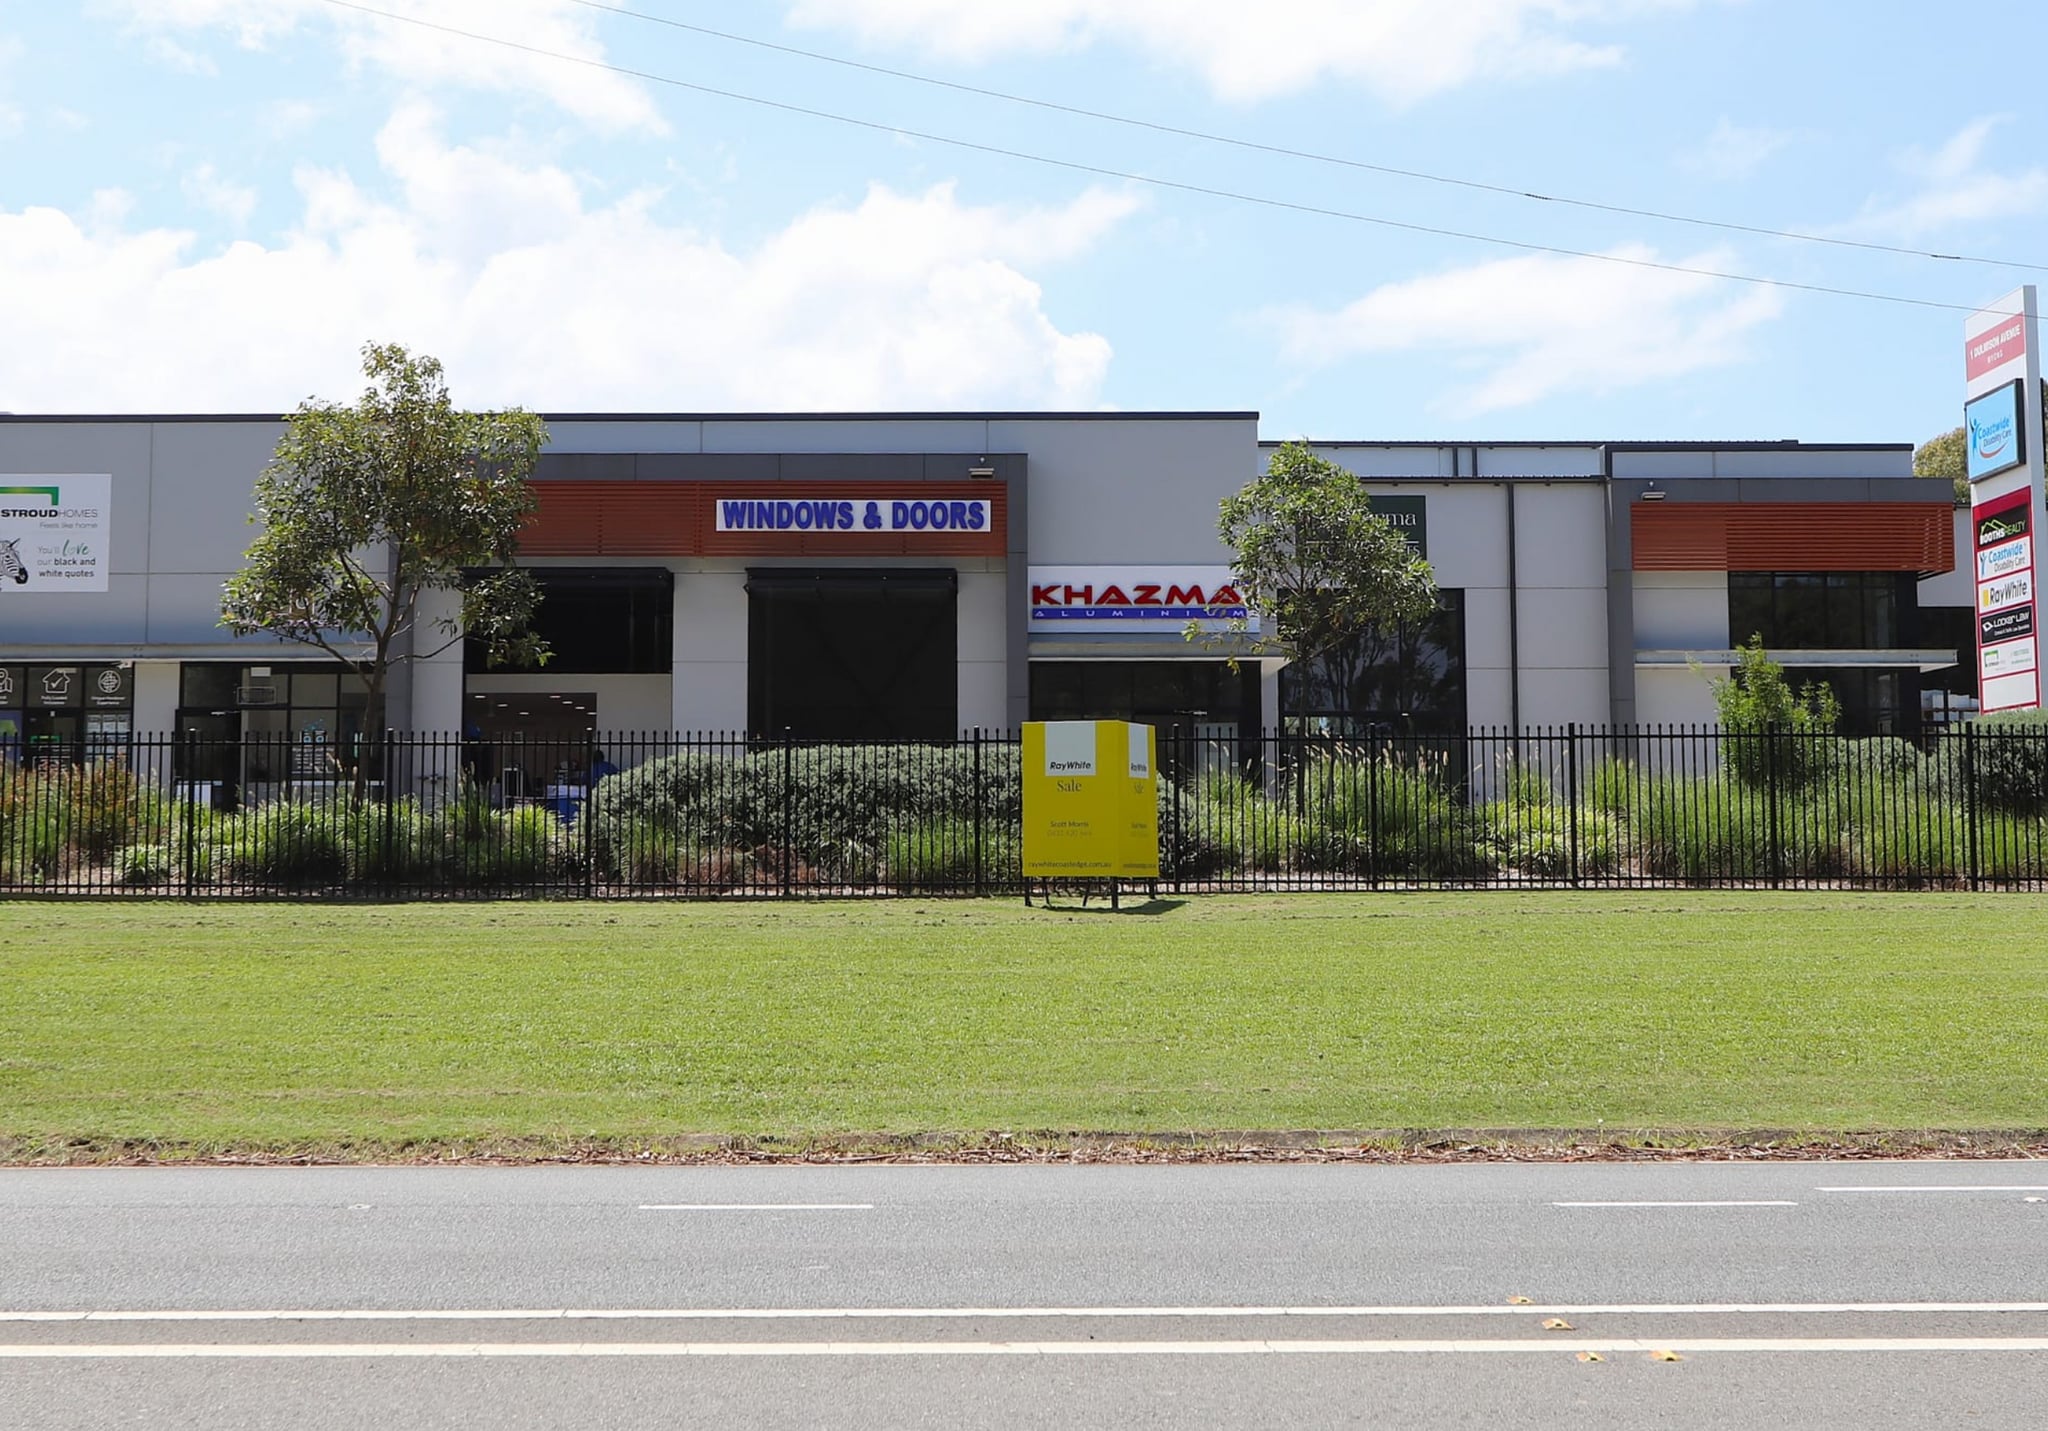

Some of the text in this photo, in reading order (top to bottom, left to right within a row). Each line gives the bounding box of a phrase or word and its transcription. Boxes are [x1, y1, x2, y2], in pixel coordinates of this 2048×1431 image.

[1978, 417, 2010, 440] Coastwide
[722, 501, 985, 529] WINDOWS & DOORS
[1989, 543, 2023, 563] Coastwide
[54, 557, 77, 566] black
[79, 557, 96, 566] and
[1994, 558, 2015, 572] Disability
[39, 569, 95, 578] white quotes
[1032, 585, 1245, 606] KHAZMA
[1056, 779, 1083, 792] Sale
[1050, 820, 1068, 828] Scott
